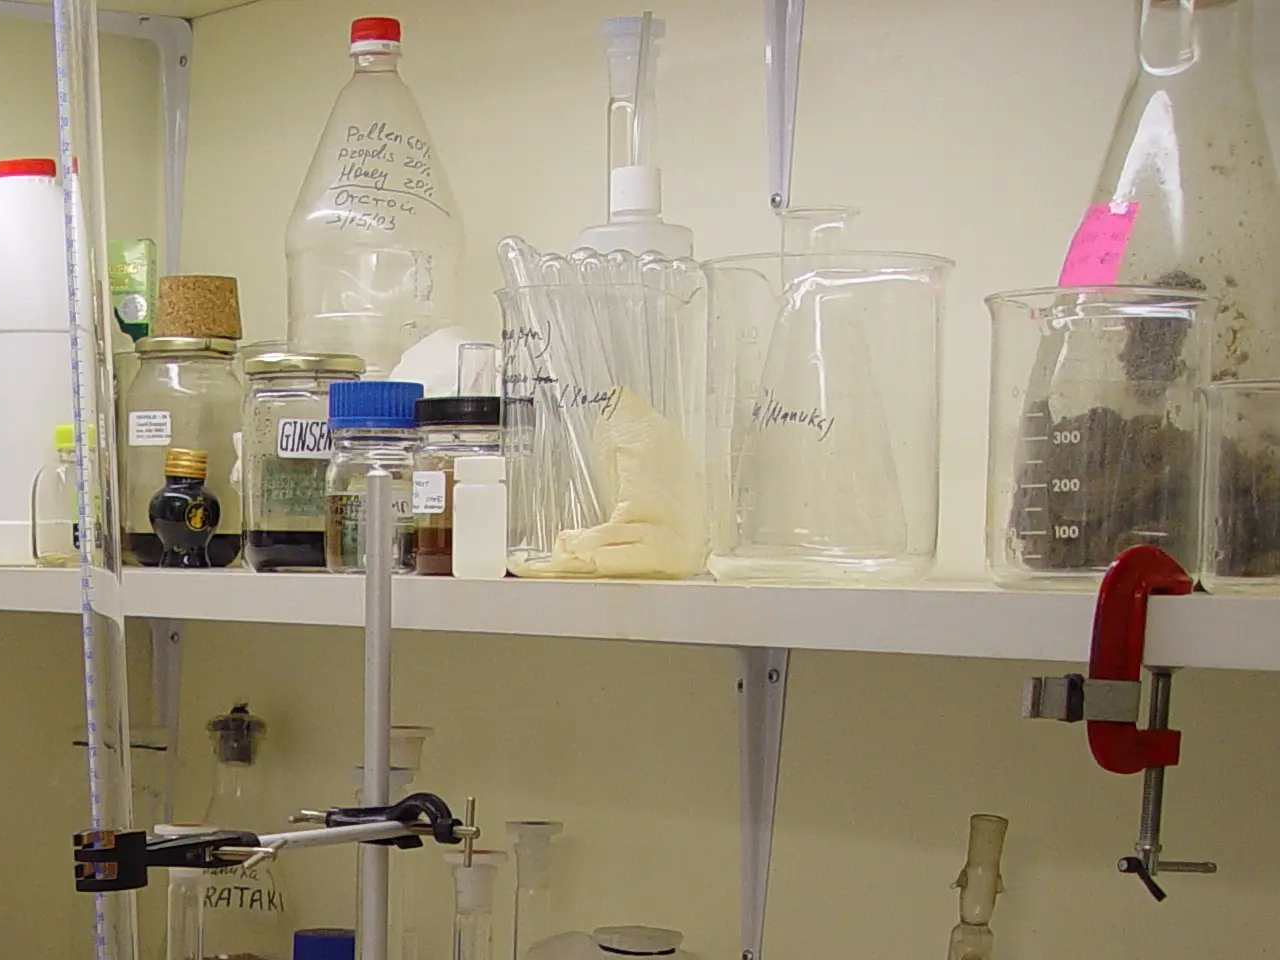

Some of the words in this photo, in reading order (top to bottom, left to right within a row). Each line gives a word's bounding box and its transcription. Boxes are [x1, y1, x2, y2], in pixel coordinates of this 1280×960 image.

[338, 162, 389, 190] Honey
[1053, 431, 1081, 445] 300
[1052, 478, 1080, 492] 200
[1054, 526, 1079, 539] 100
